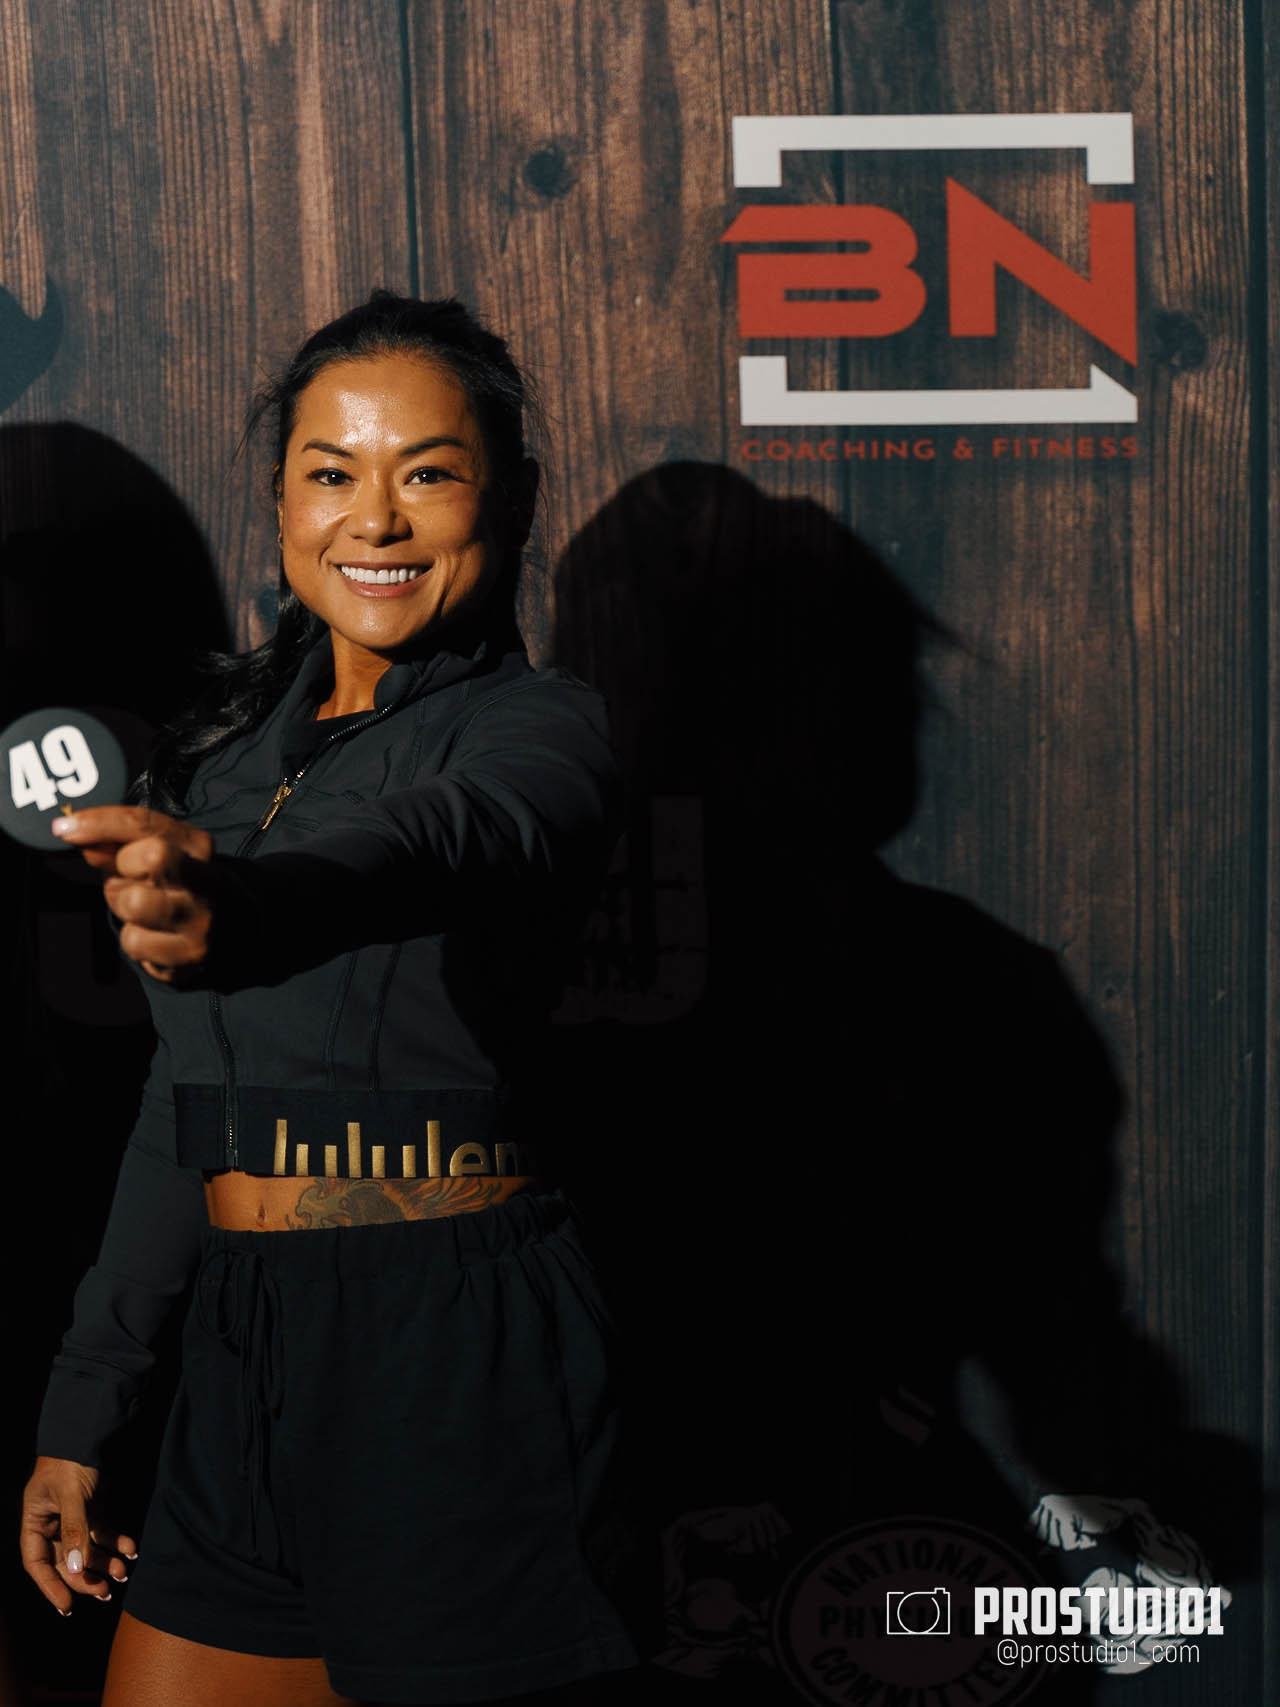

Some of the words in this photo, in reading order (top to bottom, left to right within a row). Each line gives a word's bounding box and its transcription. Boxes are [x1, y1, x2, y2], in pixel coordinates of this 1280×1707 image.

[720, 176, 1139, 368] BN
[740, 439, 937, 462] COACHING
[952, 439, 975, 462] &
[992, 436, 1139, 460] FITNESS
[8, 724, 100, 812] 49
[819, 1537, 1008, 1597] NATIONAL
